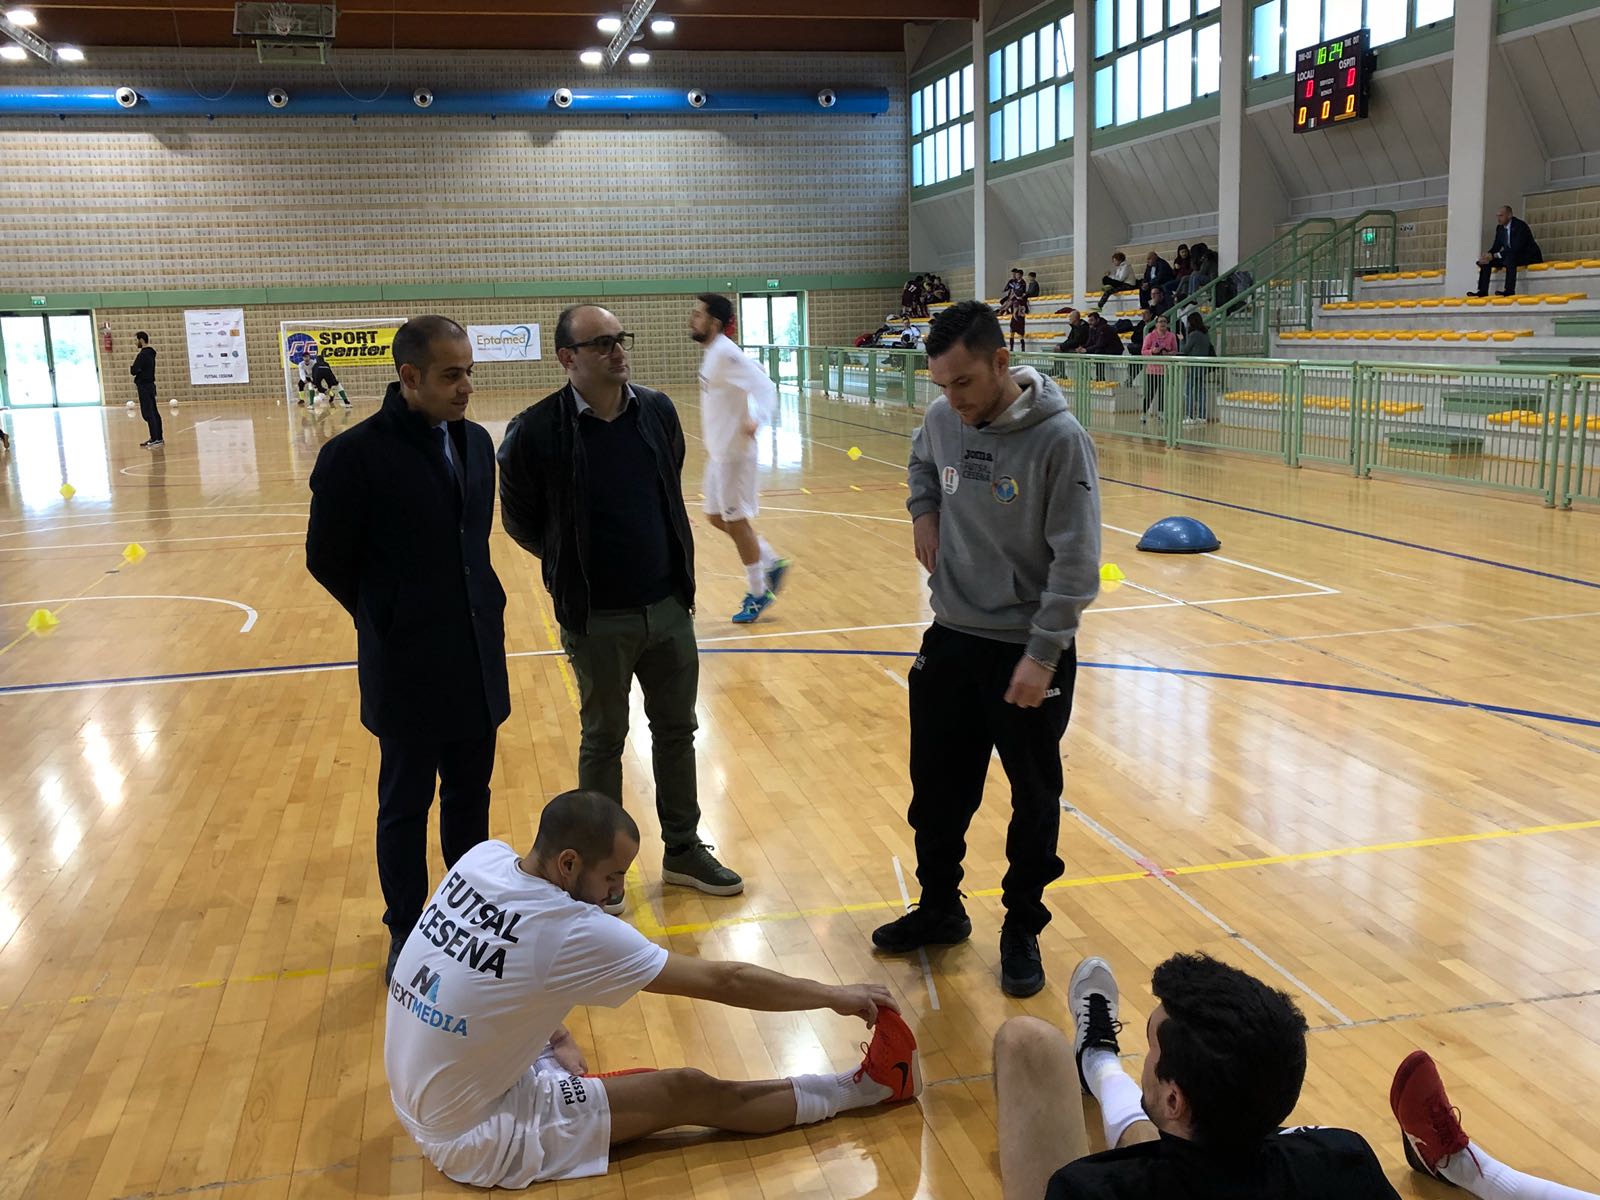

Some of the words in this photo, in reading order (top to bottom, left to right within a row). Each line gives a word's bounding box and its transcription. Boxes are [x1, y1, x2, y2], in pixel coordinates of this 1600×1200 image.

[1298, 70, 1314, 81] LOCALI
[1347, 67, 1355, 86] 0
[1306, 80, 1313, 97] 0
[1322, 101, 1330, 118] 0
[1346, 94, 1354, 112] 0
[1299, 107, 1306, 124] 0
[319, 330, 378, 345] SPORT
[320, 343, 391, 358] center
[440, 871, 521, 944] FUTSAL
[418, 903, 507, 980] CESENA
[389, 977, 468, 1037] NEXTMEDIA
